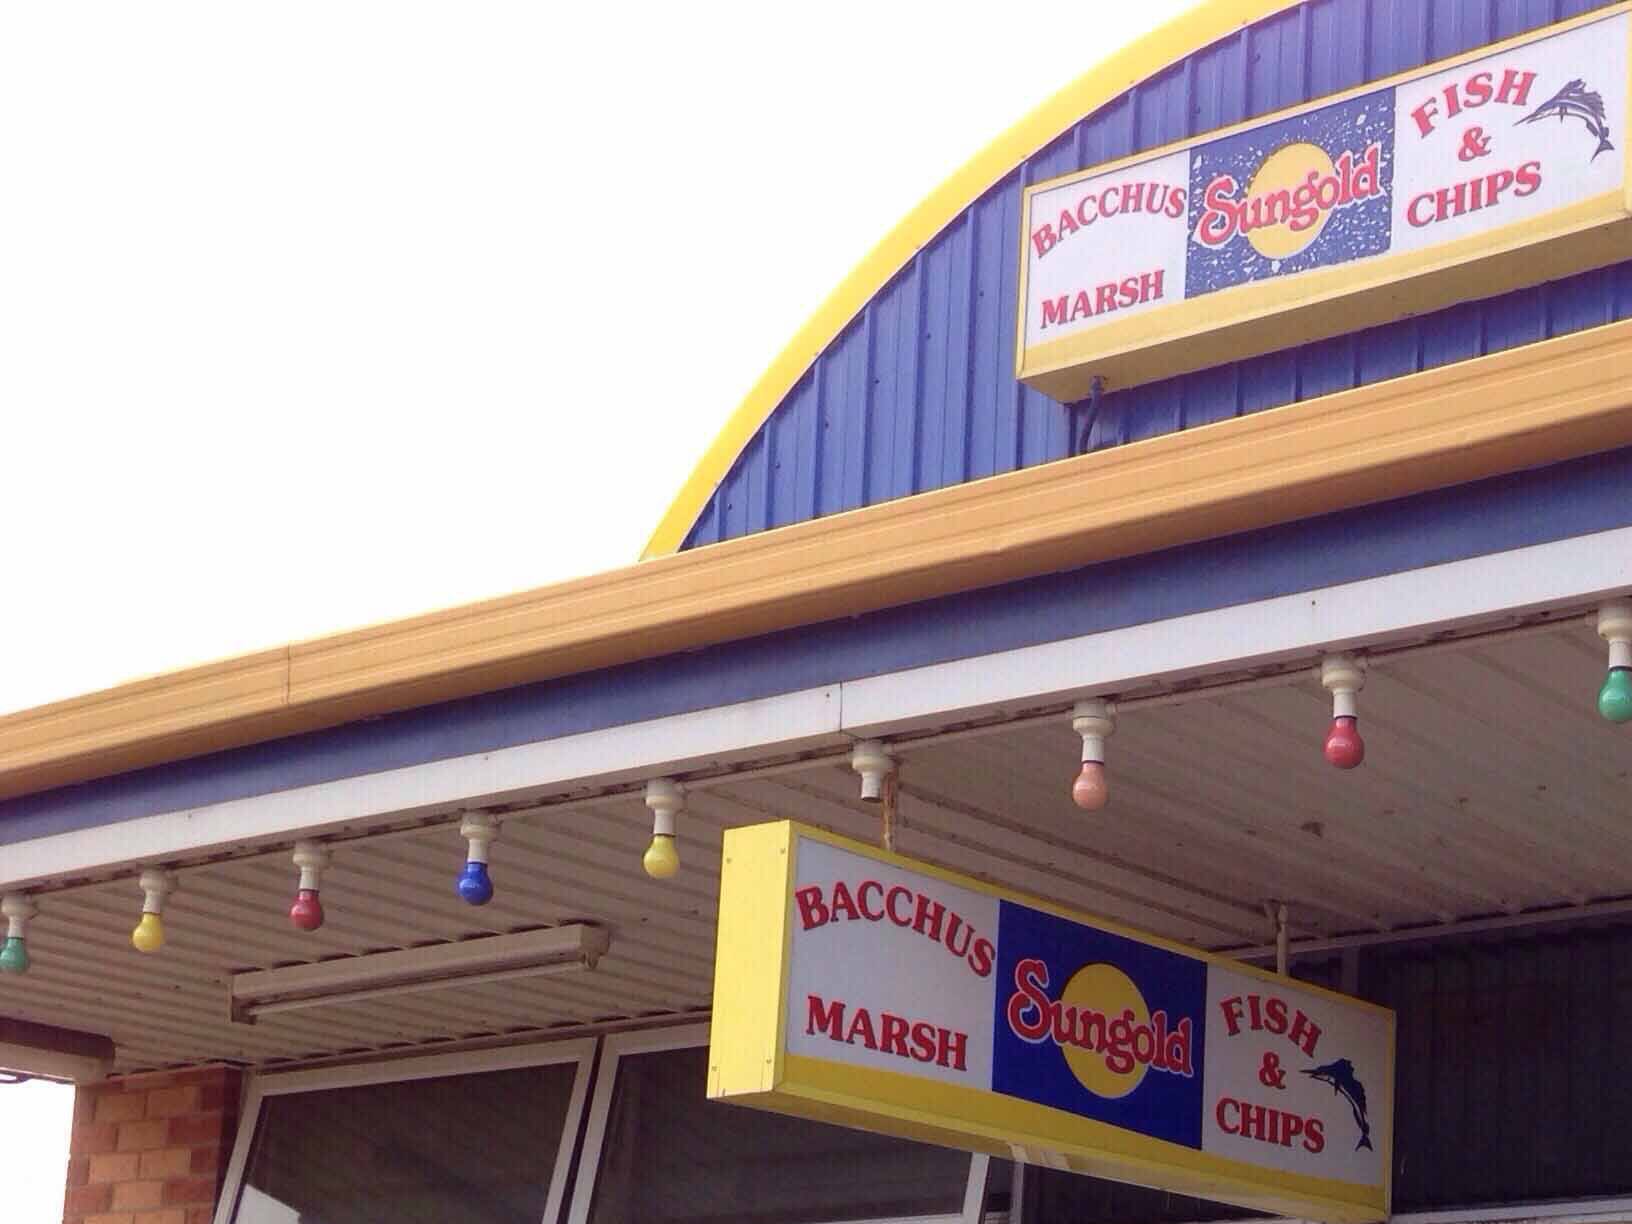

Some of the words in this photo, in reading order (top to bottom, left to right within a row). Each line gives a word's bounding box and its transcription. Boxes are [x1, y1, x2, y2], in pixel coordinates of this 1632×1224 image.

[1409, 68, 1537, 138] FISH
[1457, 126, 1492, 162] &
[1031, 182, 1187, 259] BACCHUS
[1191, 142, 1386, 248] Sungold
[1406, 161, 1543, 228] CHIPS
[1040, 269, 1166, 329] MARSH
[796, 879, 997, 979] BACCHUS
[805, 995, 968, 1073] MARSH
[1007, 957, 1196, 1079] Sungold
[1220, 994, 1323, 1059] FISH
[1258, 1051, 1287, 1091] &
[1214, 1098, 1326, 1155] CHIPS
